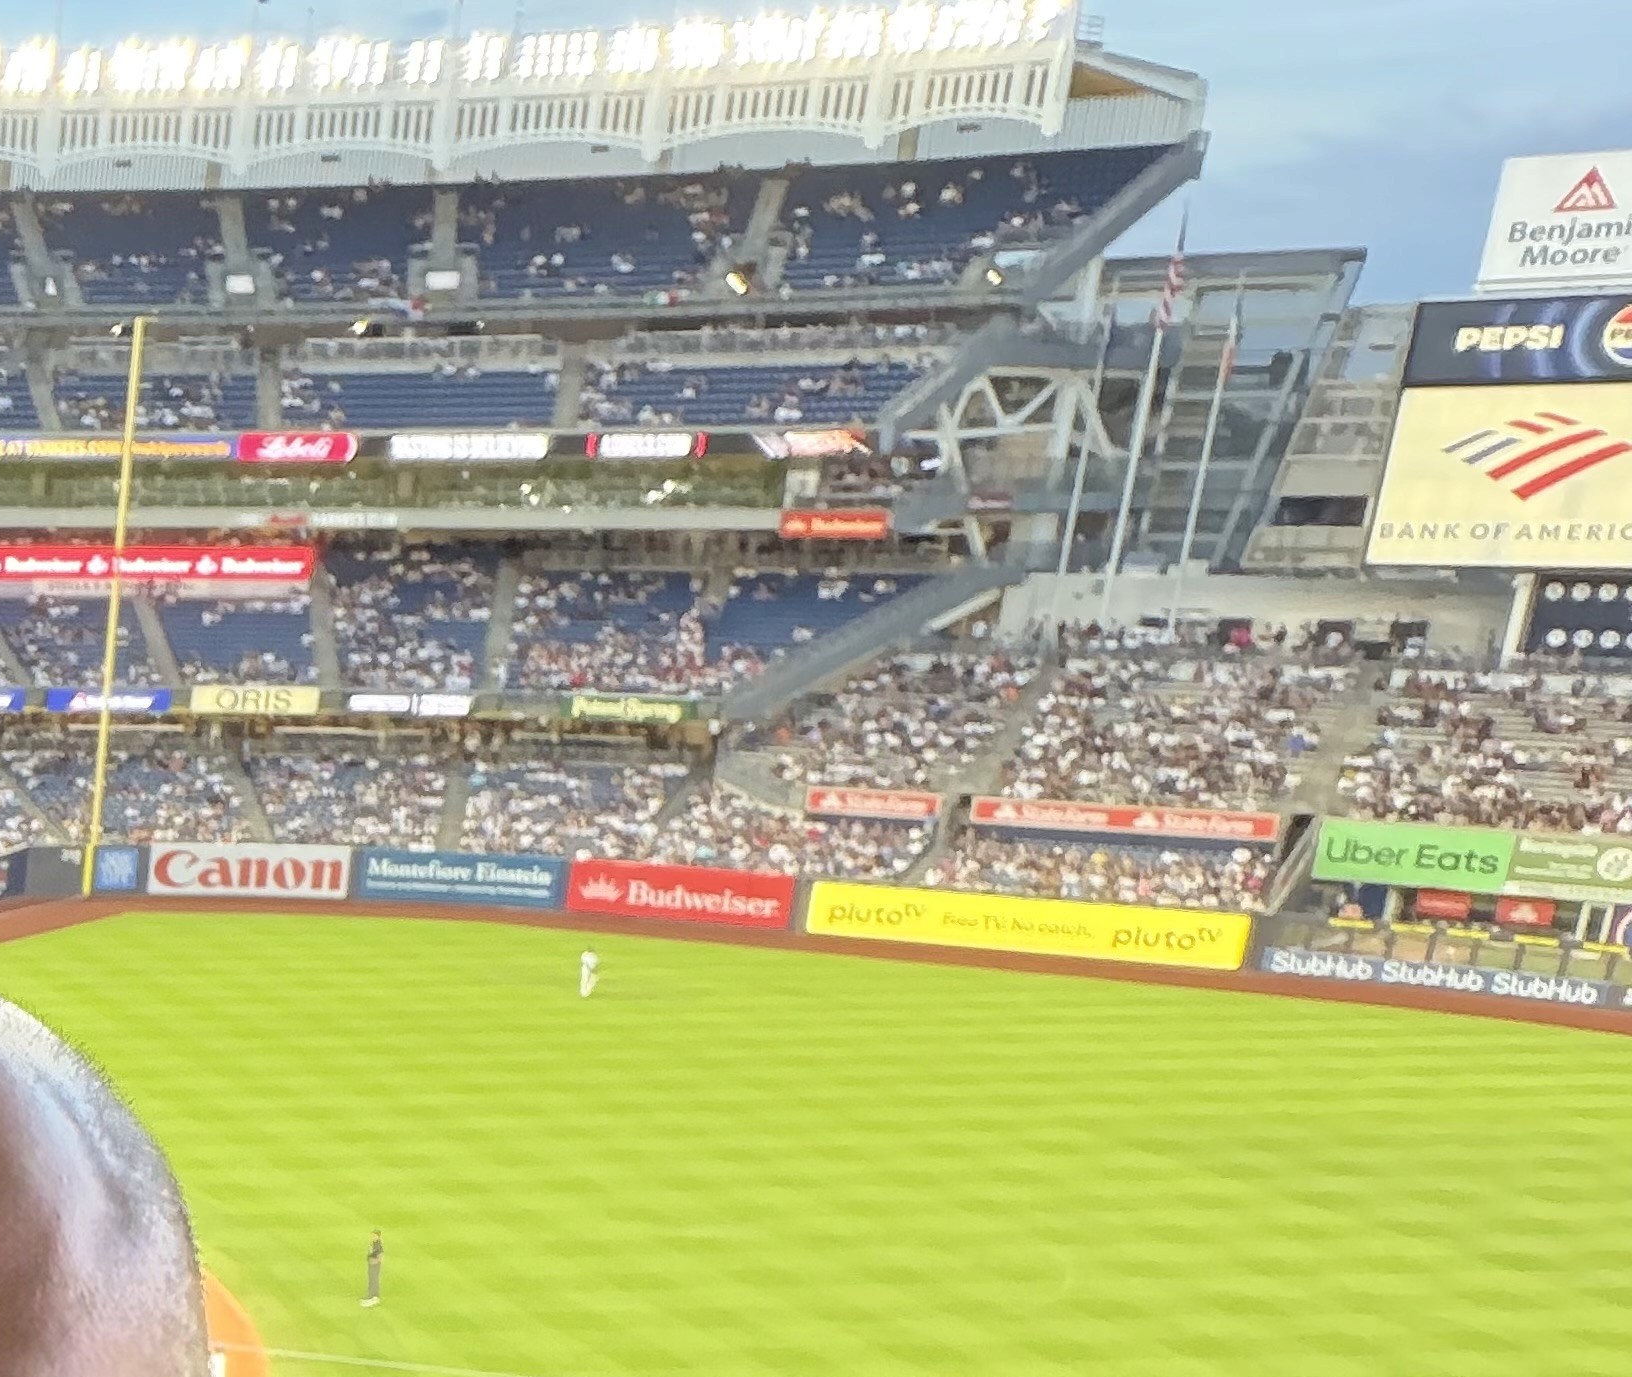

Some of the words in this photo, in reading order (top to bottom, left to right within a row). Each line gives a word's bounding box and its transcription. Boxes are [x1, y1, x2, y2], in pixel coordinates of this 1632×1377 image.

[1508, 215, 1632, 245] Benjami
[1519, 246, 1621, 267] Moore
[1454, 325, 1565, 352] PEPSI
[1379, 522, 1459, 539] BANK
[1470, 522, 1510, 540] OF
[1515, 522, 1632, 541] AMERIC
[112, 556, 192, 574] udweiser
[222, 557, 304, 574] Budweiser
[214, 689, 292, 712] ORIS
[154, 849, 343, 891] Canon
[1325, 837, 1409, 866] Uber
[1415, 843, 1500, 875] Eats
[367, 857, 471, 881] Montefiore
[476, 861, 552, 886] Einstein
[626, 878, 781, 918] Budweiser
[942, 911, 979, 928] Free
[1010, 916, 1034, 931] No
[1271, 950, 1373, 981] StubHub
[1382, 960, 1484, 992] StubHub
[1491, 971, 1598, 1005] StubHub
